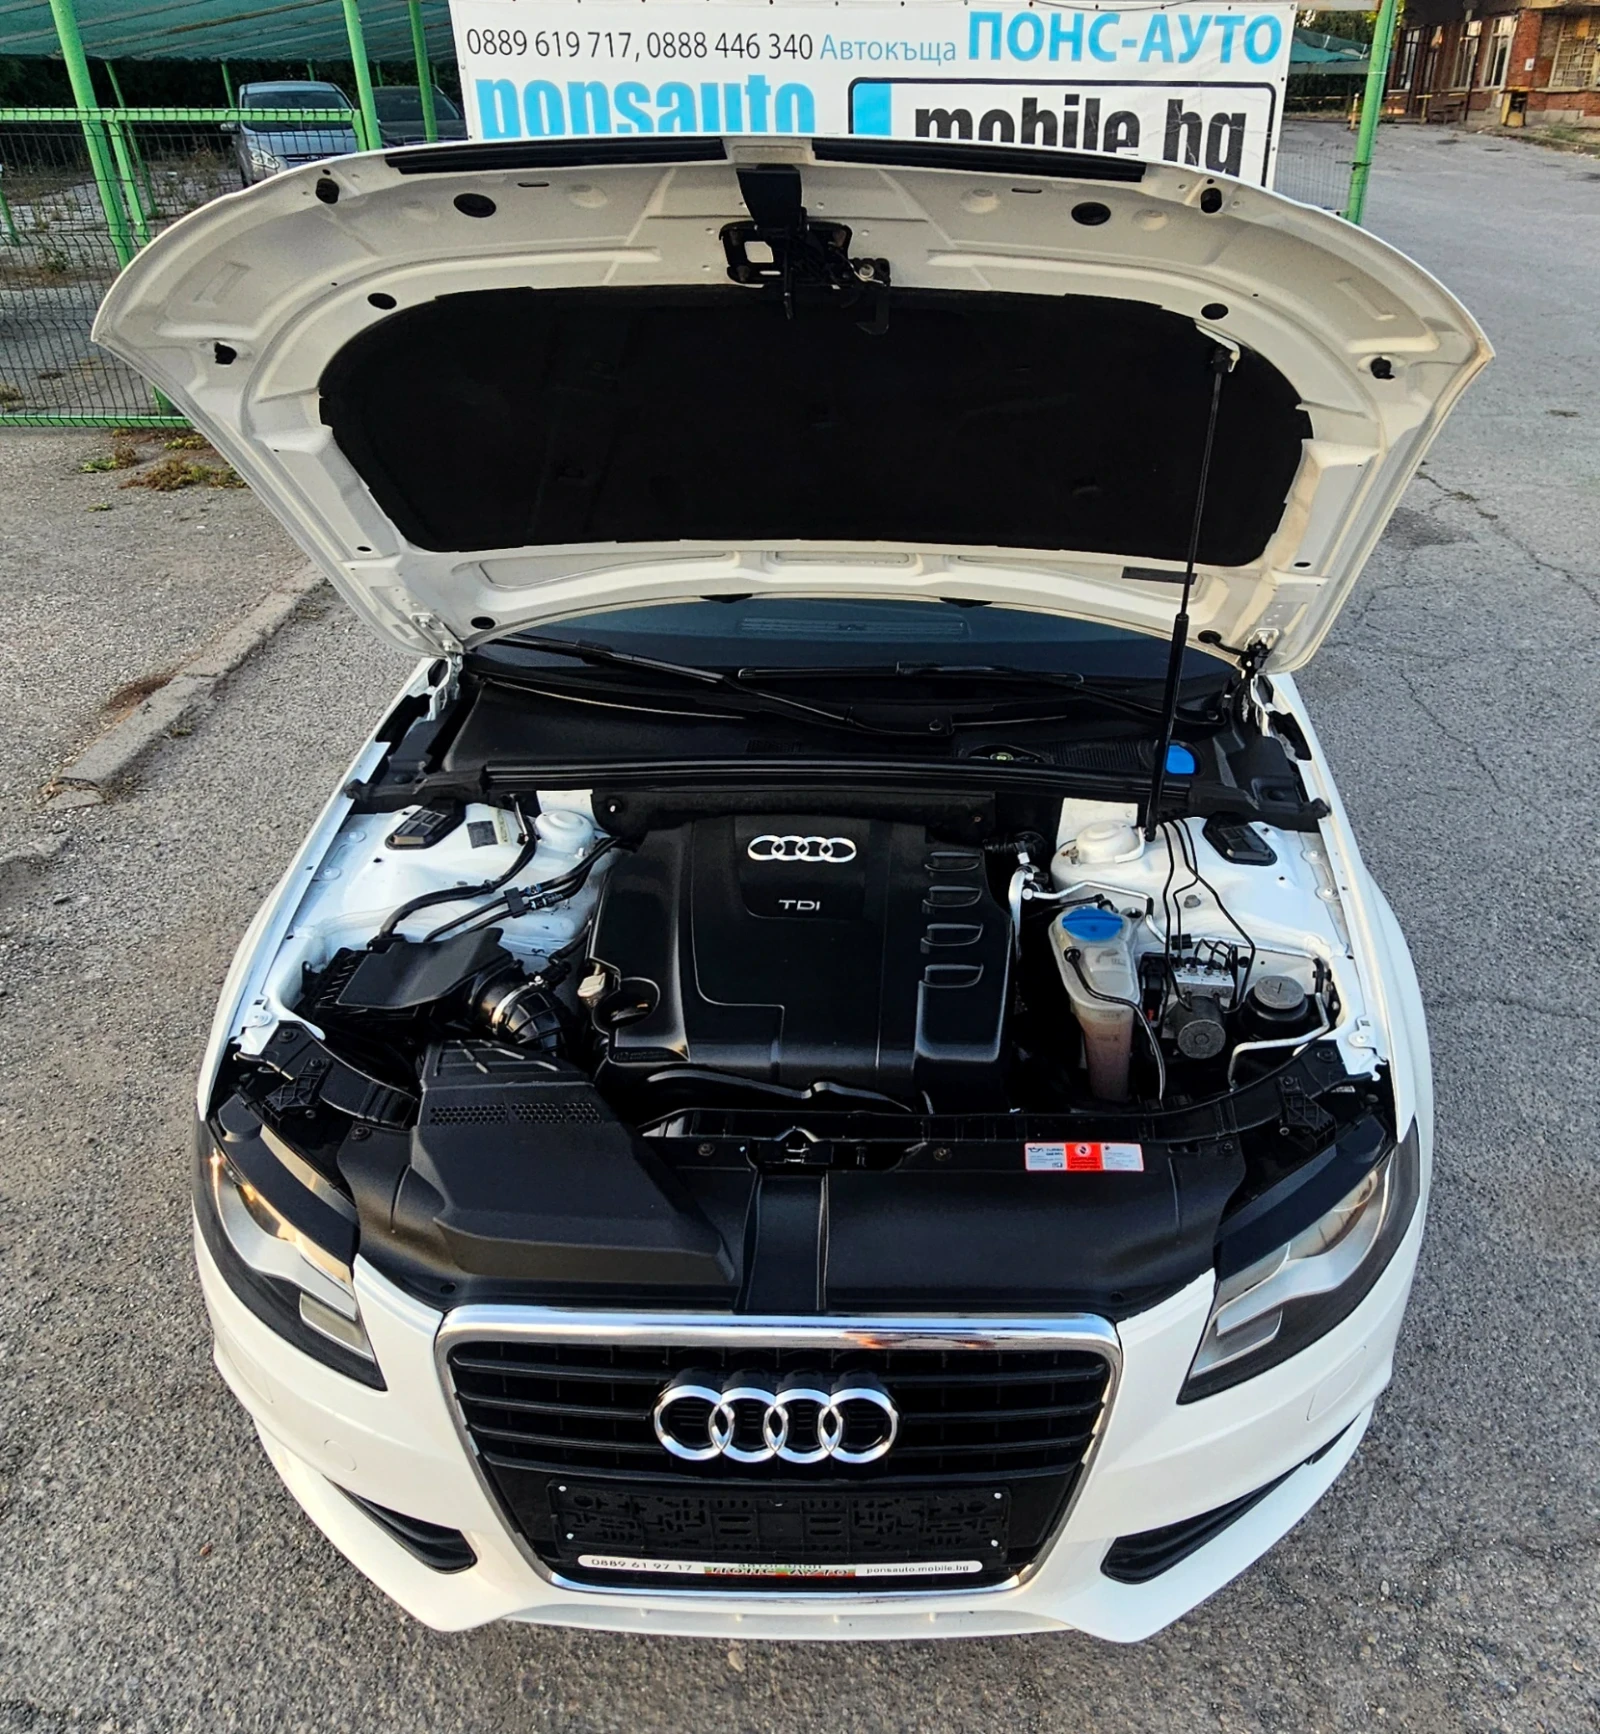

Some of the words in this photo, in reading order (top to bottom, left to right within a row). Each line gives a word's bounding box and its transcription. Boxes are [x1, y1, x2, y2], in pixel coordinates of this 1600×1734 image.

[466, 28, 528, 56] 0889
[535, 30, 580, 58] 619
[587, 31, 640, 63] 717,
[646, 31, 708, 59] 0888
[714, 32, 761, 60] 446
[768, 33, 813, 61] 340
[820, 34, 956, 66] Автокъща
[968, 11, 1282, 65] ПОНС-АУТО
[914, 93, 1247, 178] mobilebg
[778, 899, 821, 911] TDI
[866, 1564, 970, 1574] ponsauto.mobile.bg
